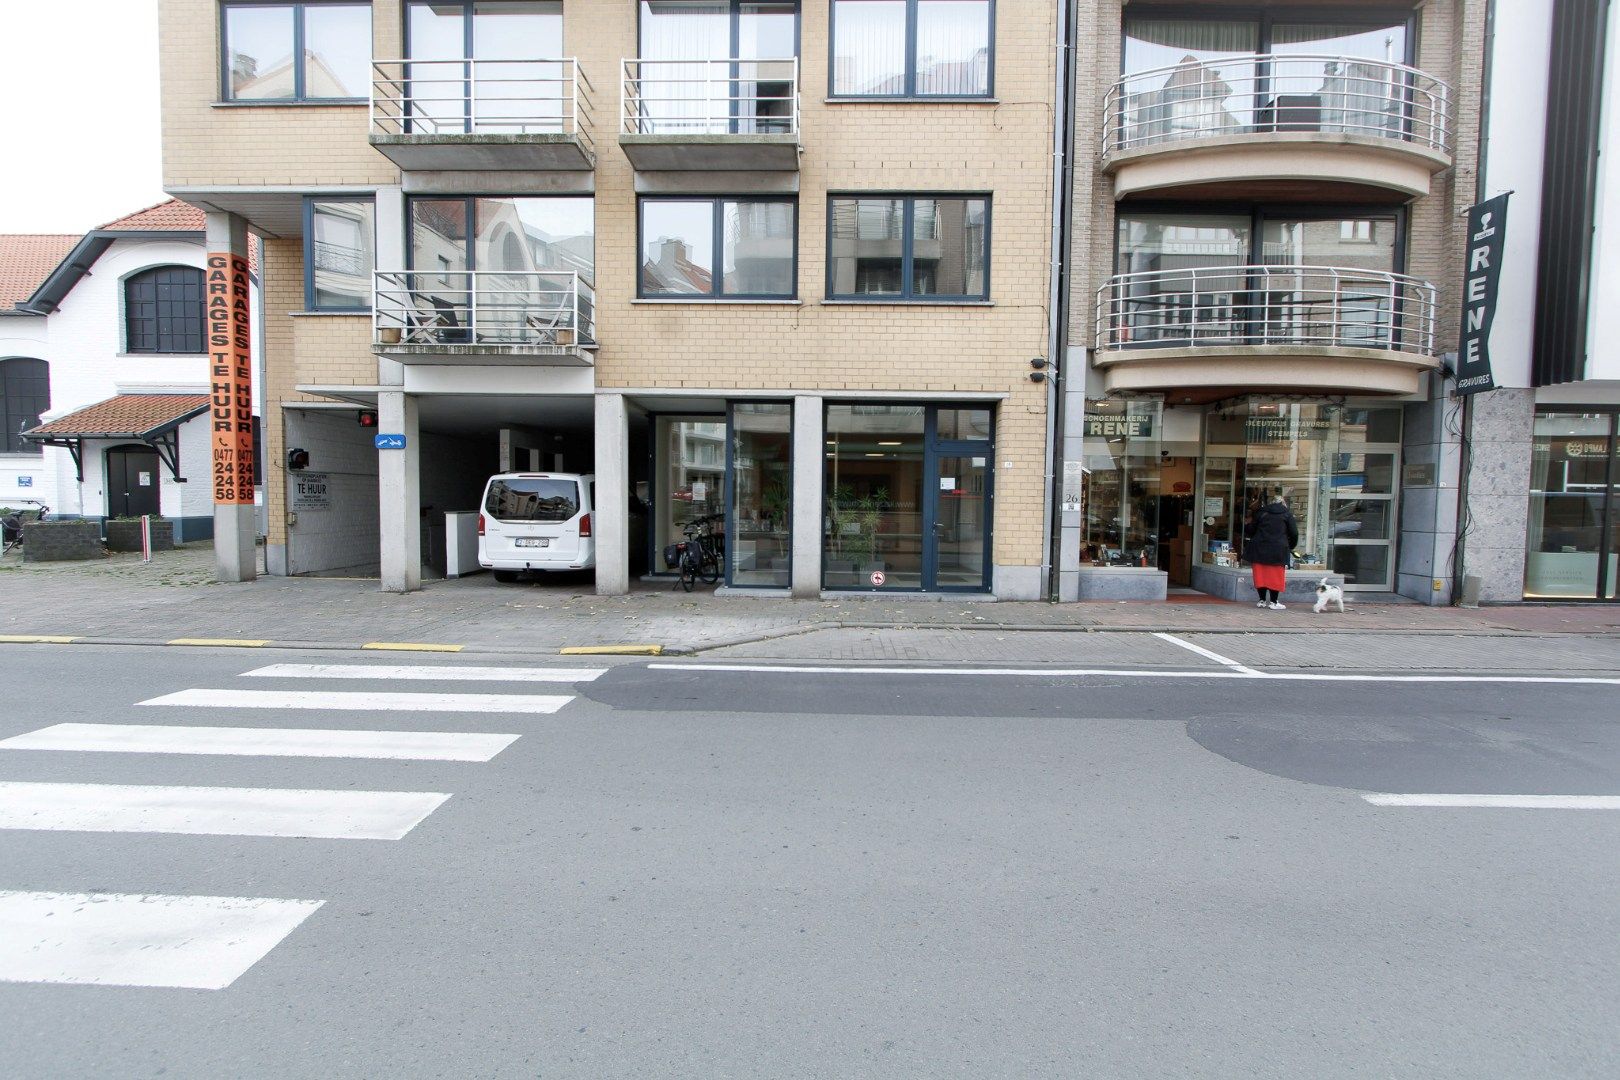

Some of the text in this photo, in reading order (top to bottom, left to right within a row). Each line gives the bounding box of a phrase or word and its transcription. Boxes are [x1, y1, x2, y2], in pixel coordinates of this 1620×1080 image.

[1466, 245, 1490, 364] RENE
[208, 256, 232, 432] GARAGES TE HUUR
[232, 259, 252, 434] GARAGES TE HUUR
[1458, 374, 1490, 388] GRAVURES
[1090, 422, 1140, 436] RENE
[214, 449, 233, 461] 0477
[238, 449, 253, 462] 0477
[215, 462, 234, 474] 24
[238, 462, 253, 474] 24
[215, 475, 234, 487] 24
[239, 475, 253, 487] 24
[215, 488, 235, 500] 58
[239, 488, 254, 500] 58
[297, 483, 327, 495] TE HUUR
[1065, 493, 1078, 503] 26
